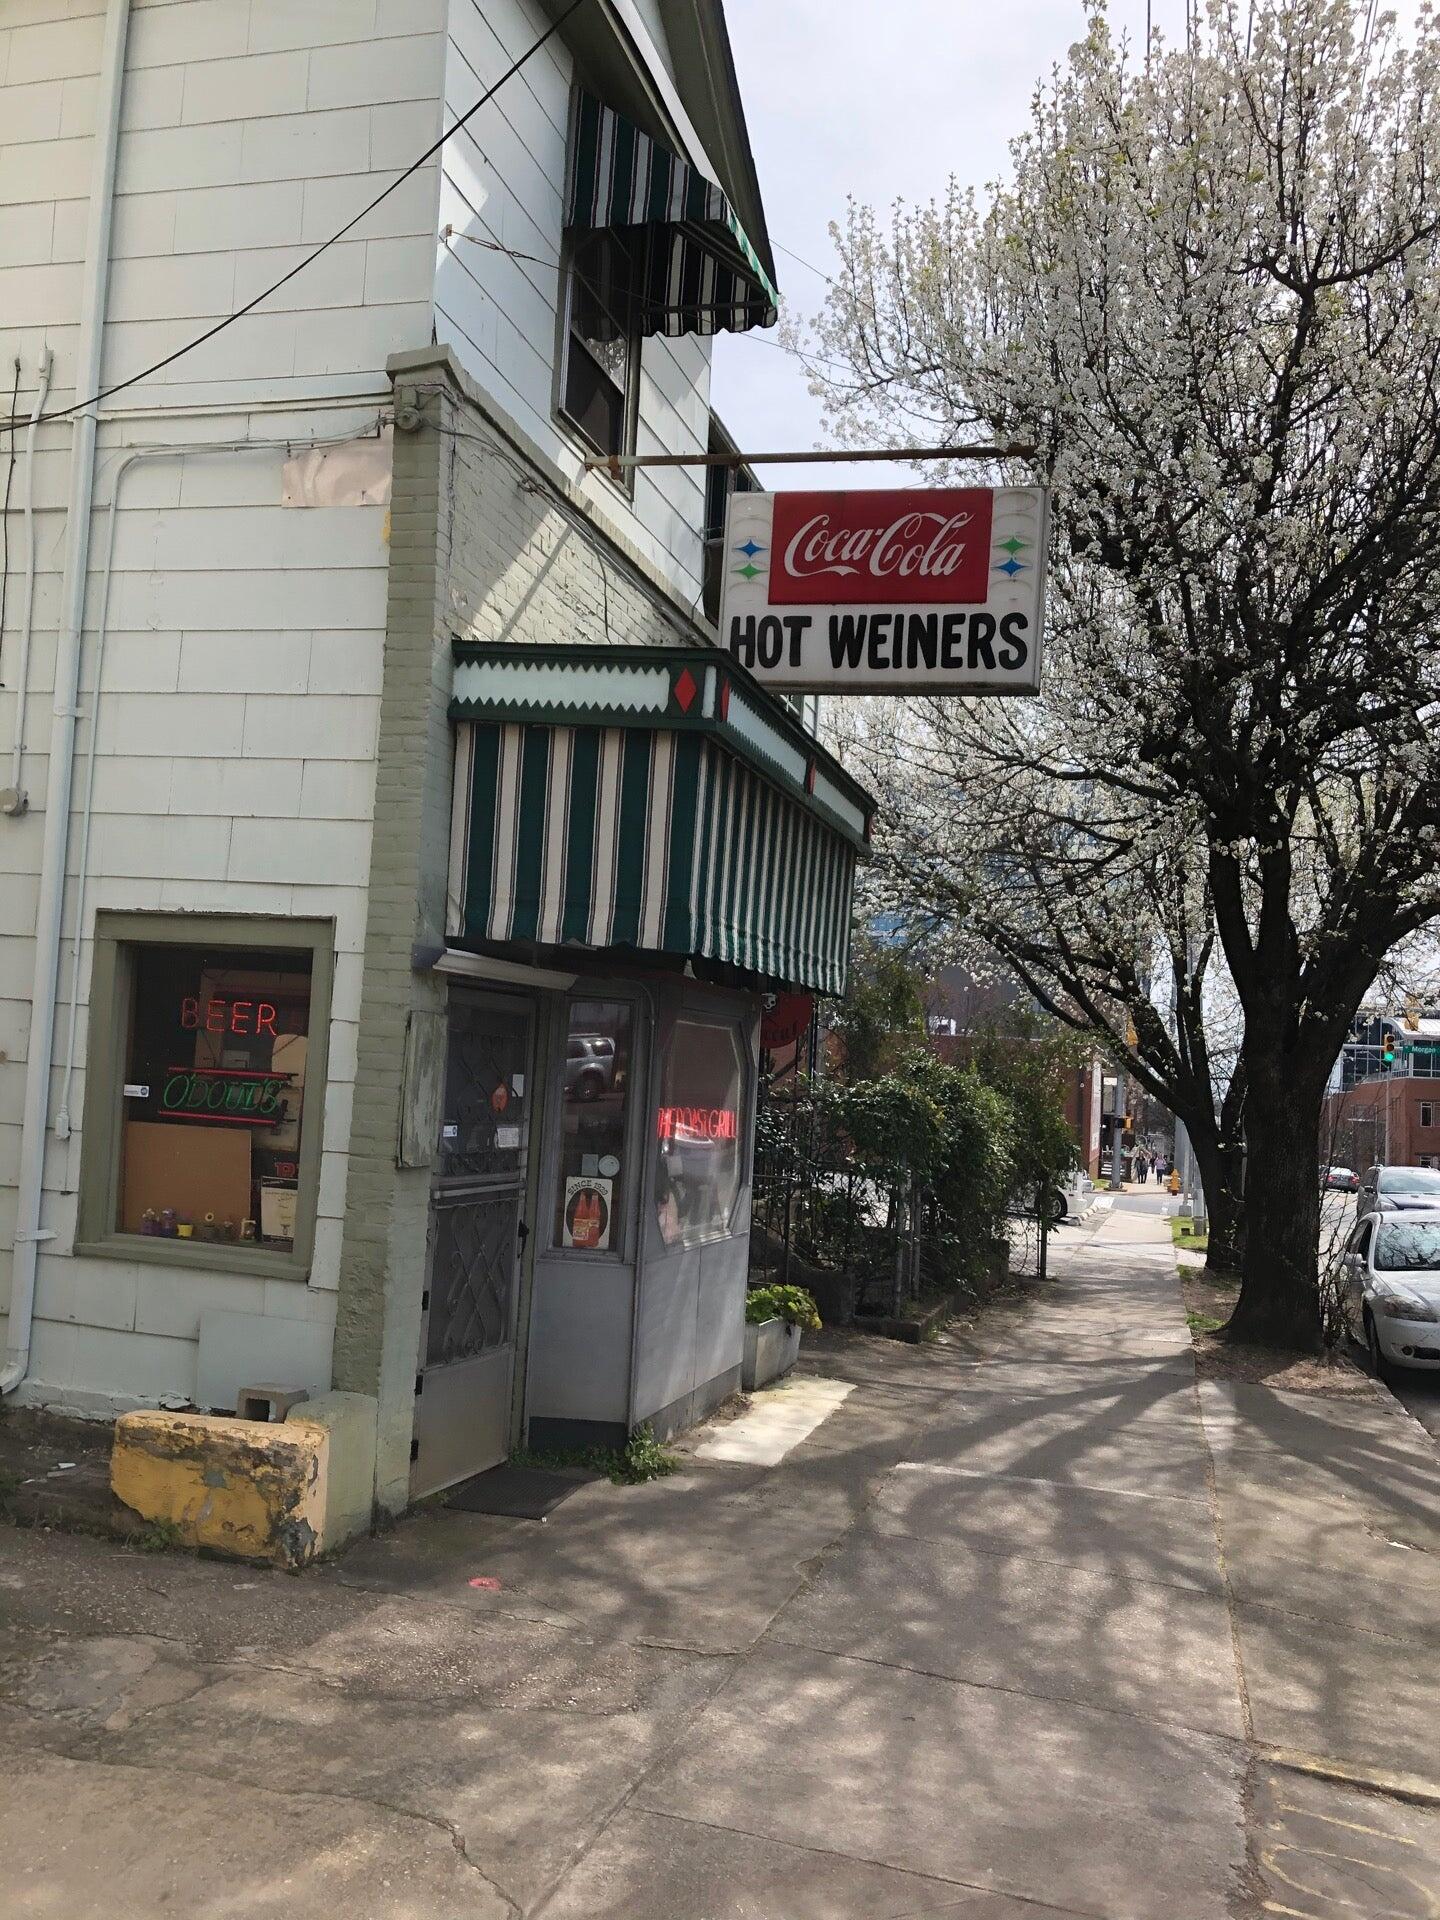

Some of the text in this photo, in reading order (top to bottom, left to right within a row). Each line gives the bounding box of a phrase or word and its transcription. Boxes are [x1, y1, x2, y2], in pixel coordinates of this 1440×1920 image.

[784, 512, 974, 577] Coca-Cola
[730, 612, 1029, 670] HOT WEINERS
[181, 998, 277, 1035] BEER
[1411, 1046, 1436, 1054] Morgan
[708, 1109, 736, 1138] GRILL
[567, 1180, 592, 1196] SINCE
